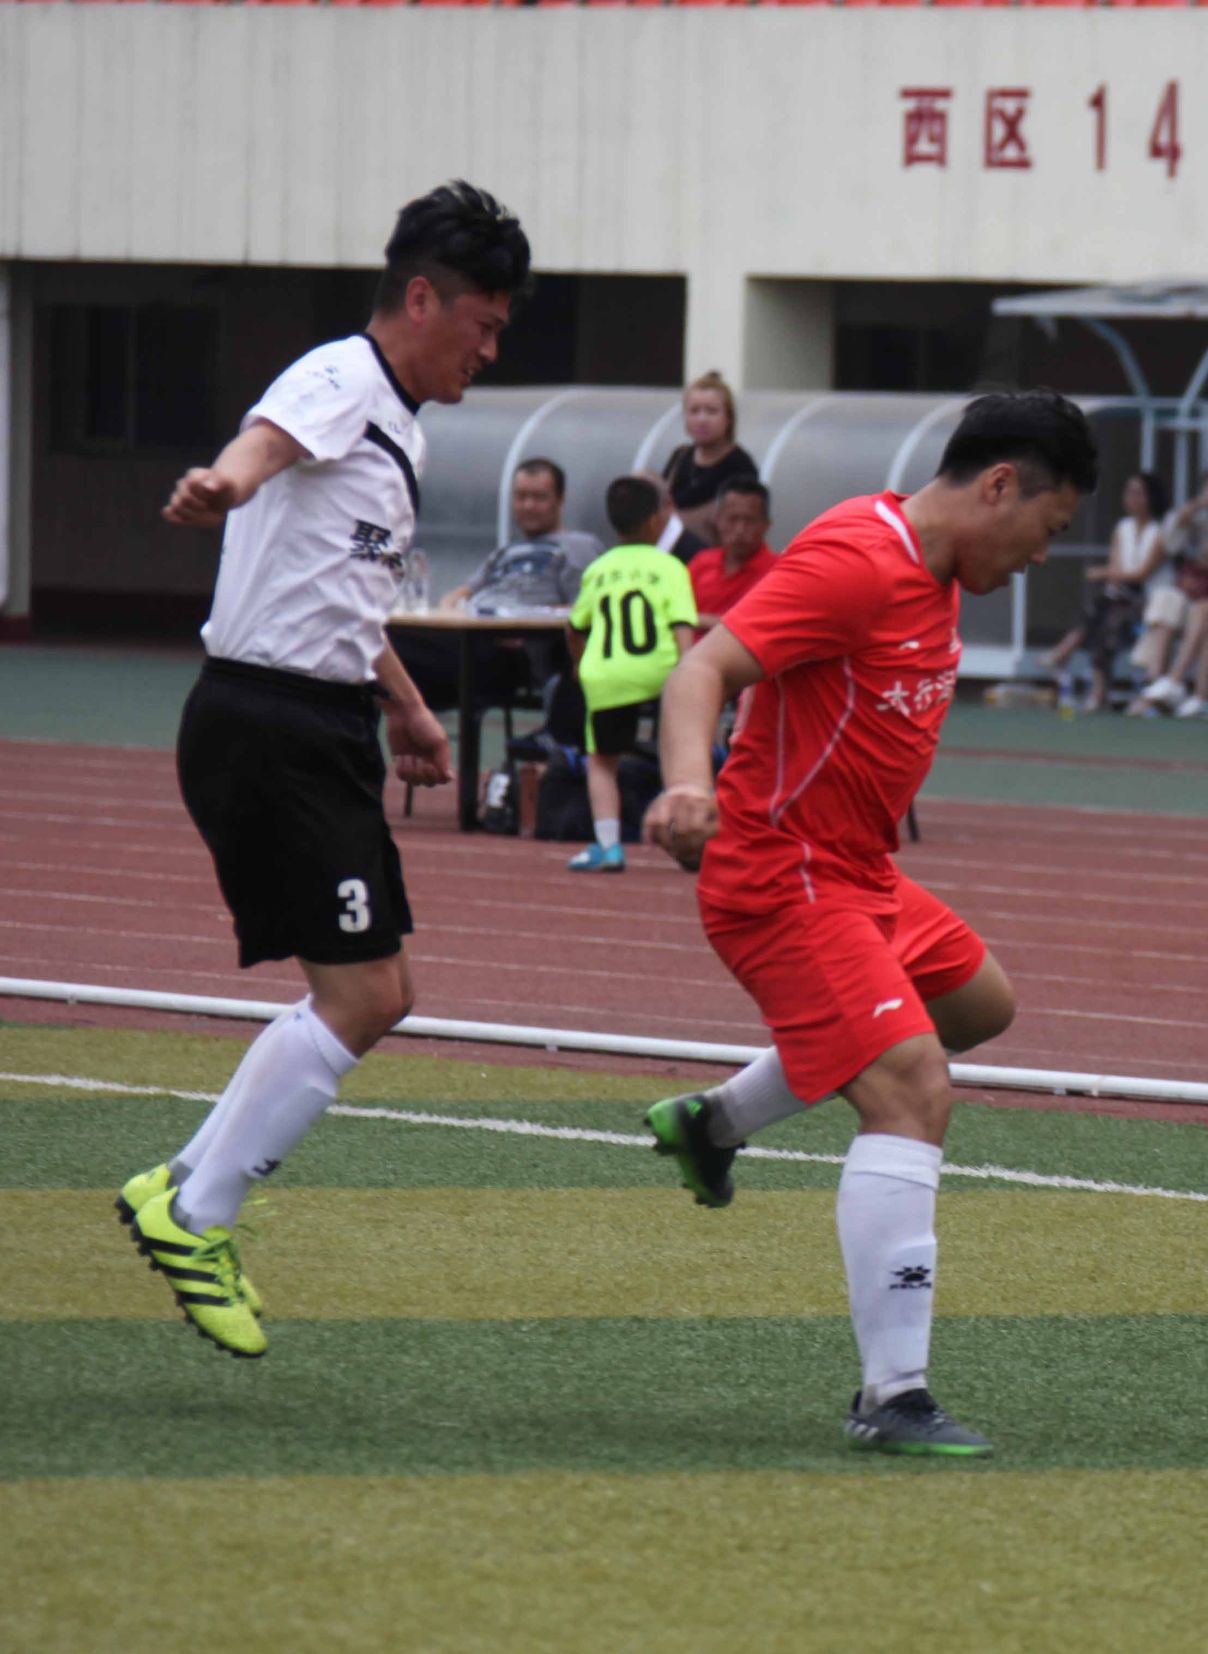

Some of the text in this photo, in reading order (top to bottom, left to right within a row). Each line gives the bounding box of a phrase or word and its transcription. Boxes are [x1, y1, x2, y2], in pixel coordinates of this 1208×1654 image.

[899, 78, 1183, 179] 西区 14
[599, 587, 657, 658] 10
[337, 878, 370, 933] 3
